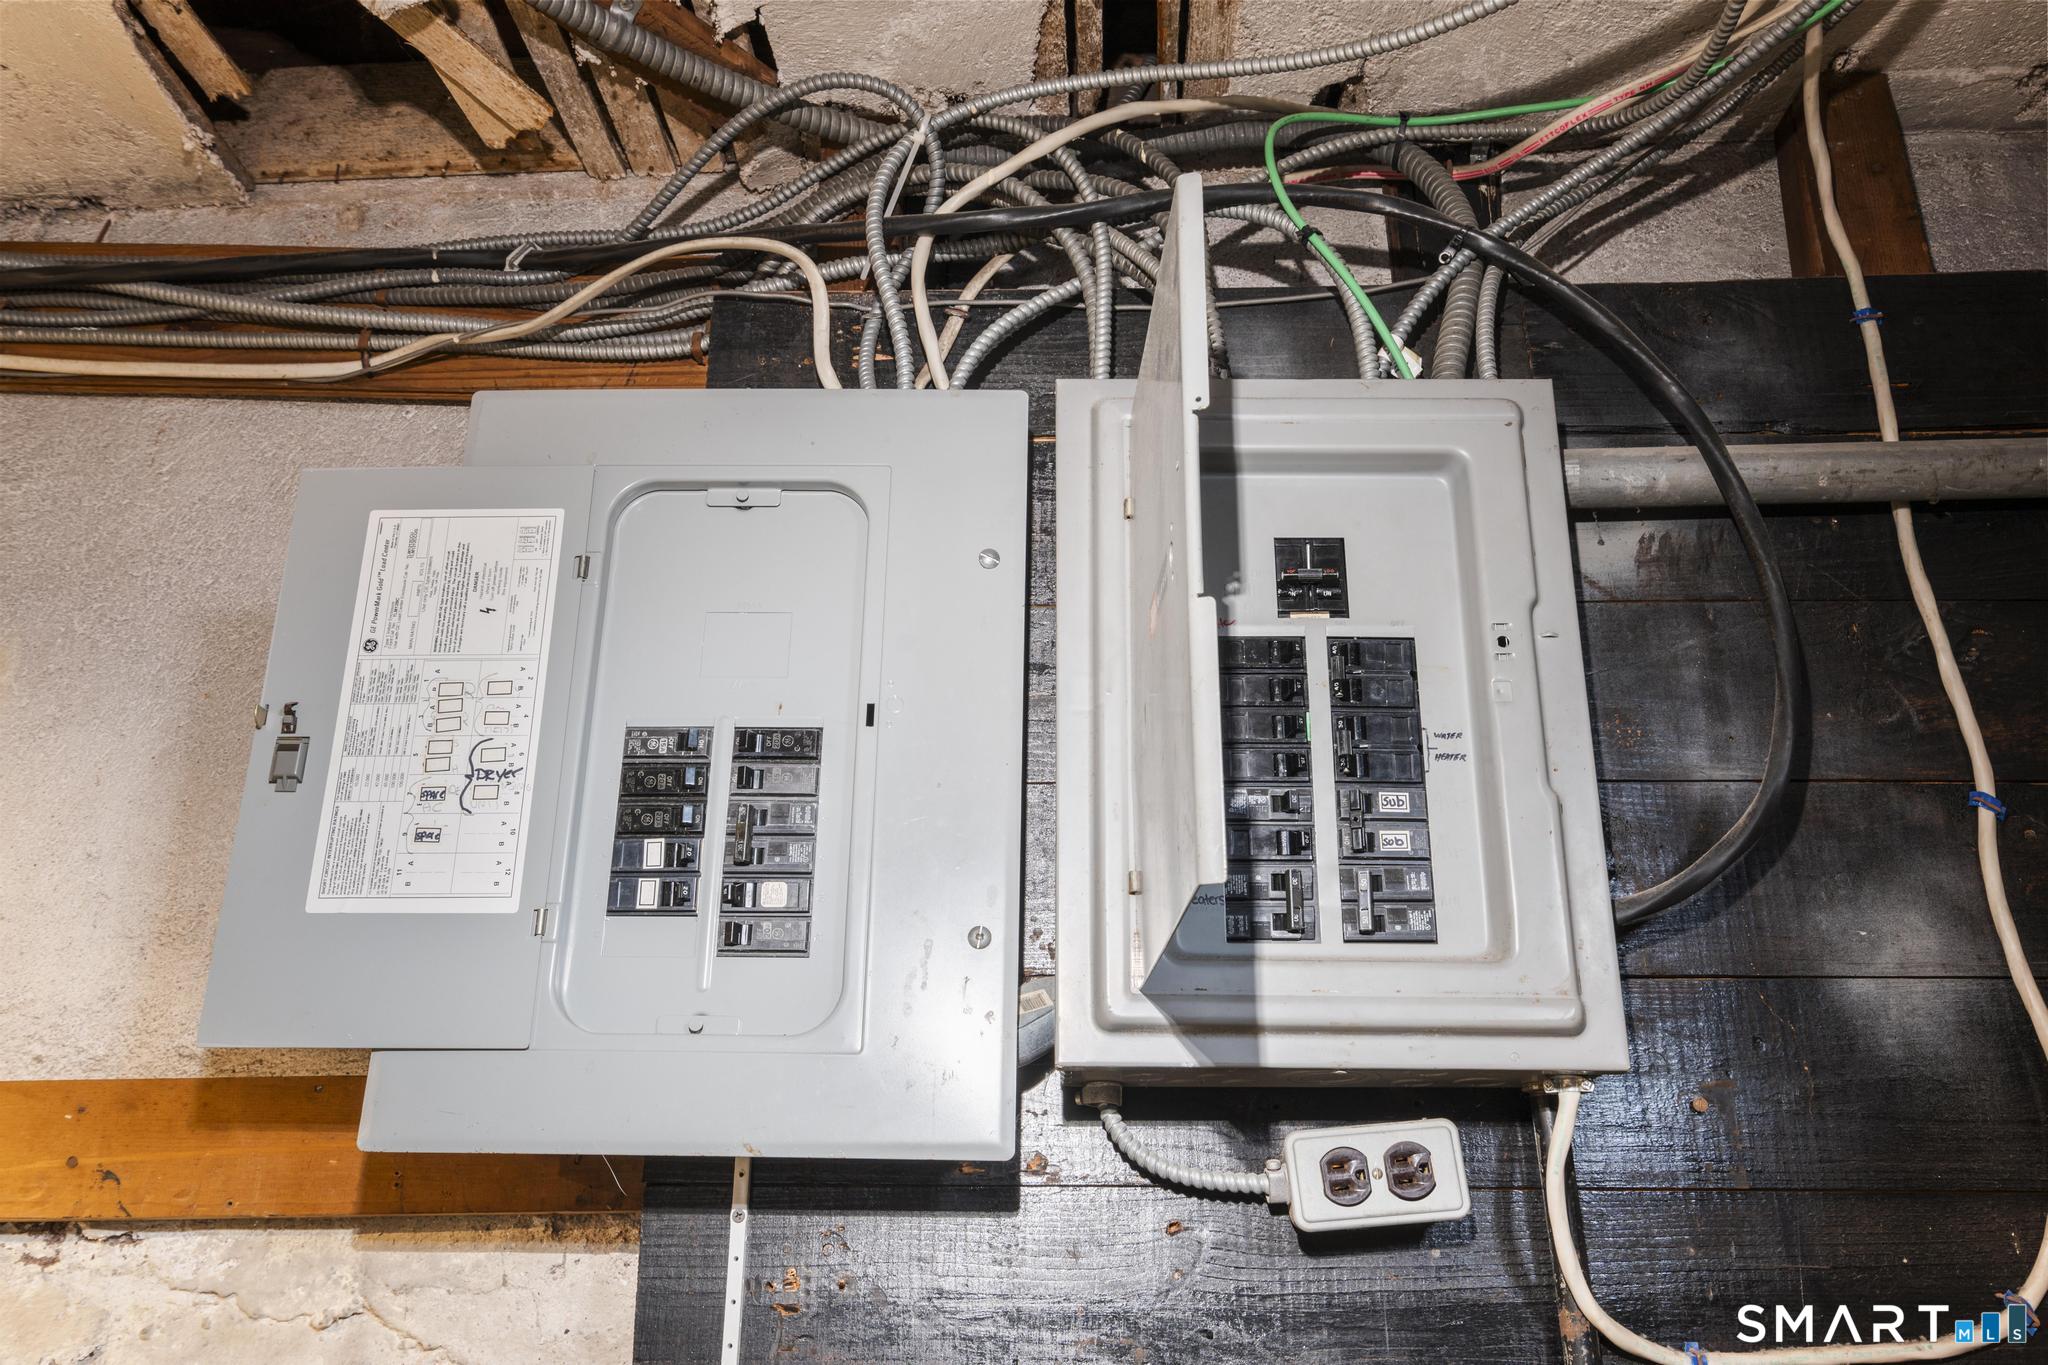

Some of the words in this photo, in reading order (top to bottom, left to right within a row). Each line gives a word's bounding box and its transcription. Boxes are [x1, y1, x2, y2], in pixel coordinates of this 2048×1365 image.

[1613, 90, 1636, 102] TYPE
[371, 593, 381, 624] PowerMark
[382, 539, 390, 557] Center
[1434, 732, 1463, 740] WATER
[1434, 753, 1467, 762] HEATER
[698, 776, 704, 786] ON
[510, 828, 516, 836] 10
[687, 846, 692, 856] 20
[396, 868, 402, 876] 11
[505, 868, 510, 876] 12
[682, 885, 689, 895] 20
